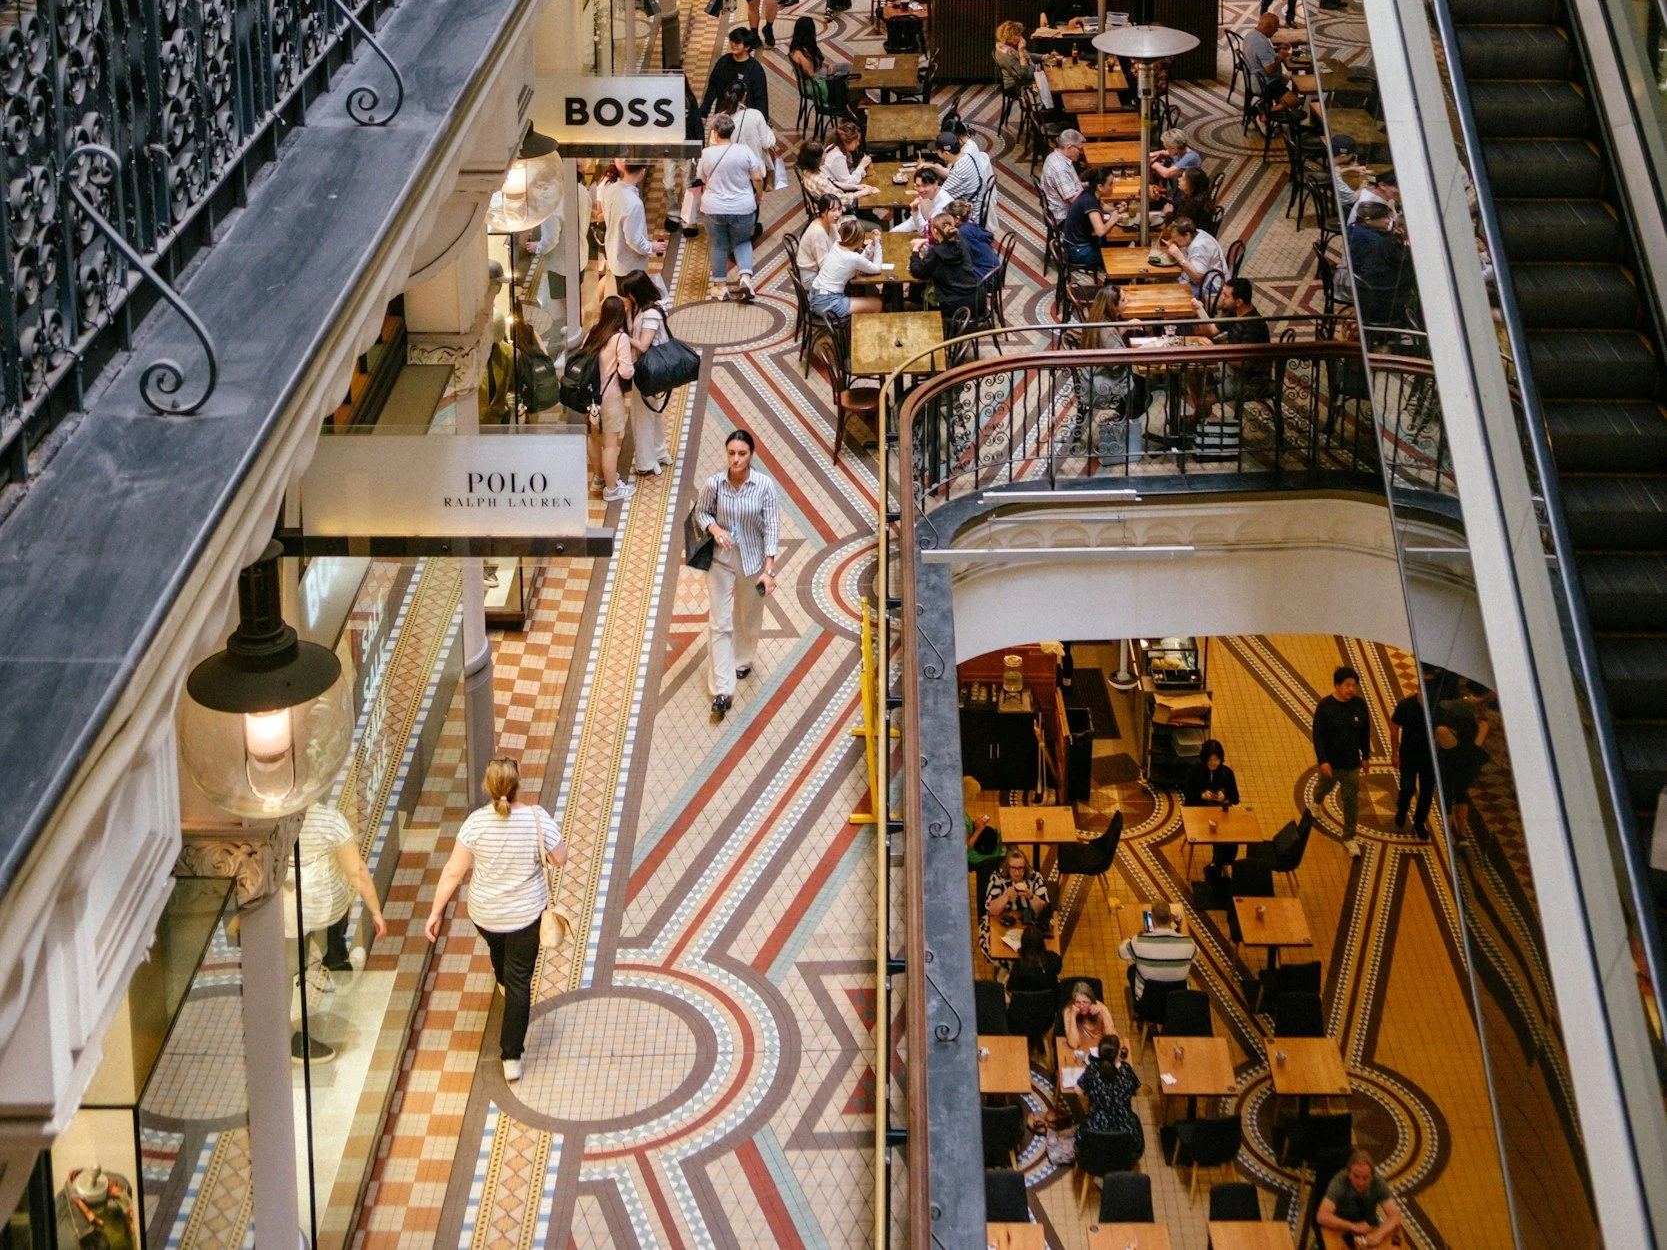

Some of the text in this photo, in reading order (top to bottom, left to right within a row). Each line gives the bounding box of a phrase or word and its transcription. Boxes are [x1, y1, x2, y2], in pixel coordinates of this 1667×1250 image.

[565, 97, 675, 128] BOSS
[467, 472, 549, 494] POLO
[444, 497, 572, 508] RALPH LAUREN
